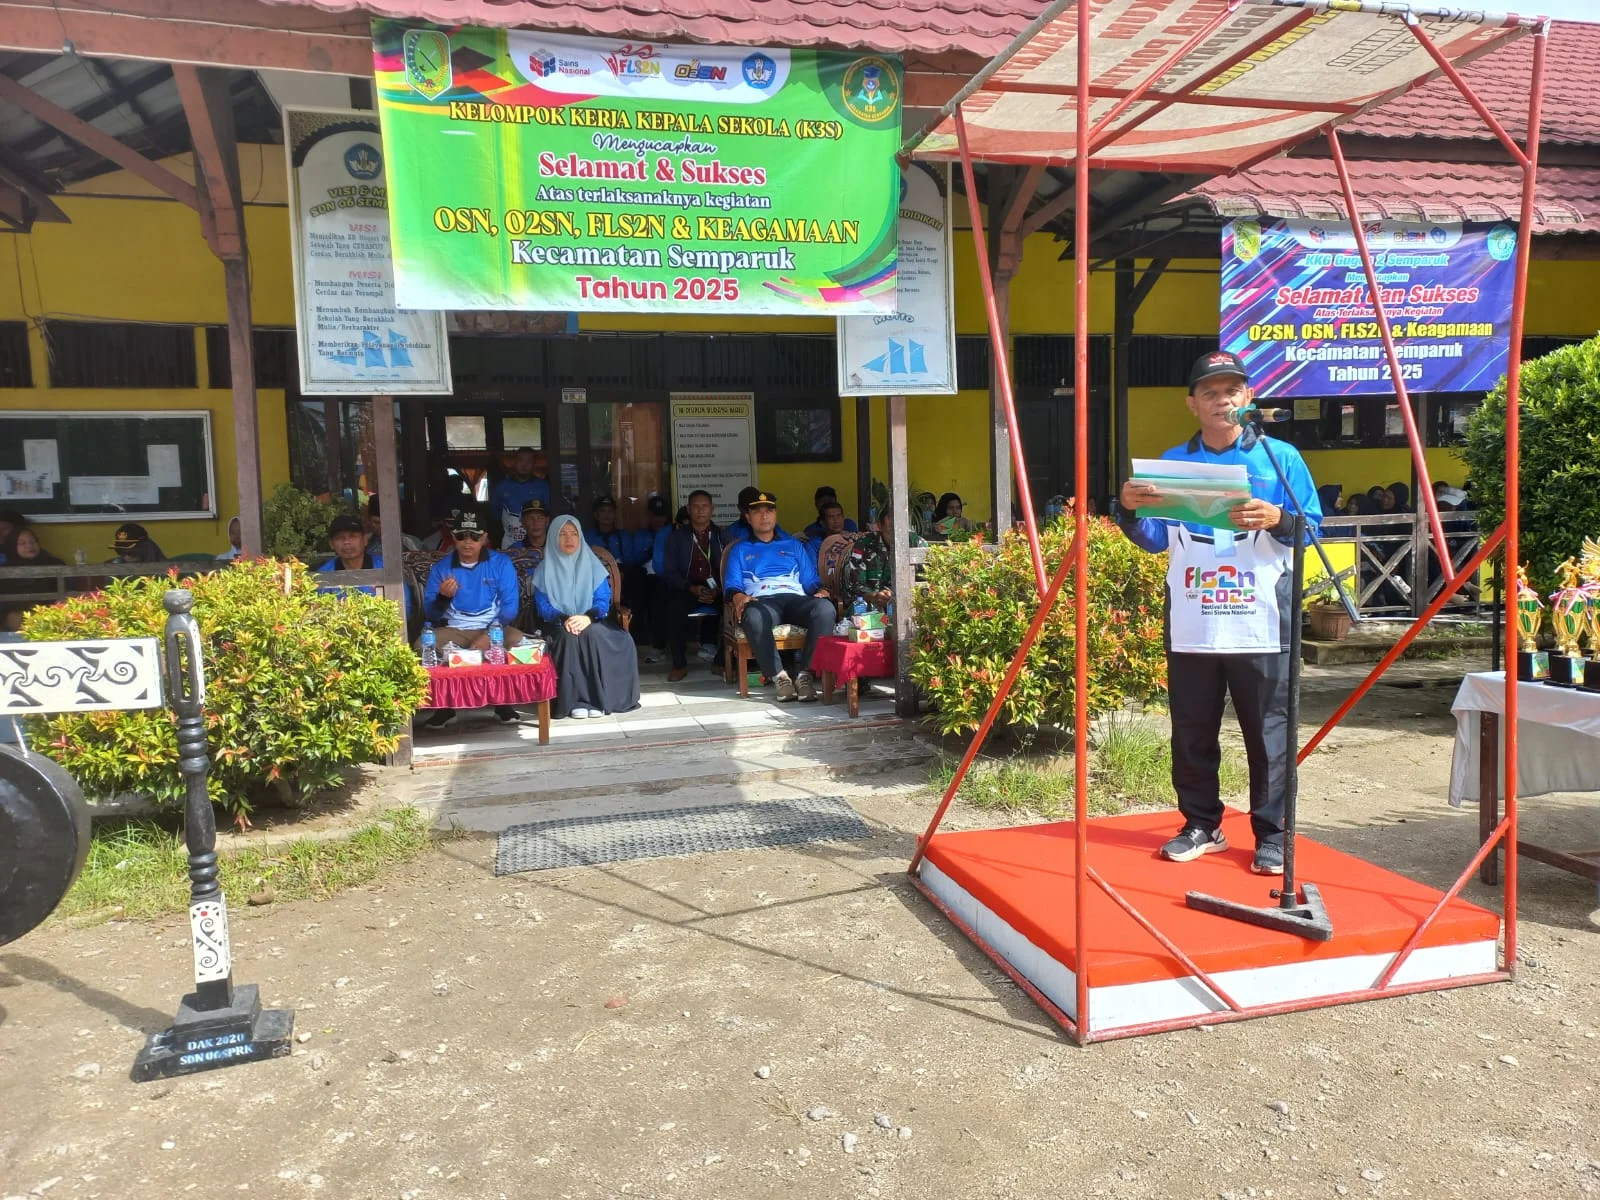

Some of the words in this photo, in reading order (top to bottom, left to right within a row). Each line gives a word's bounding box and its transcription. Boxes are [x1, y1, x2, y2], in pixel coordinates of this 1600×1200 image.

[558, 59, 579, 67] Sains
[558, 66, 591, 76] Nasional
[450, 101, 565, 126] KELOMPOK
[570, 107, 632, 129] KERJA
[636, 111, 714, 134] KEPALA
[718, 115, 791, 138] SEKOLA
[795, 119, 843, 140] (K3S)
[592, 132, 716, 158] Mengucapkan
[539, 151, 649, 180] Selamat
[655, 157, 675, 183] &
[681, 158, 767, 185] Sukses
[327, 185, 357, 199] VISI
[359, 184, 370, 197] &
[536, 185, 574, 202] Atas
[578, 187, 701, 210] terlaksanaknya
[704, 191, 772, 210] kegiatan
[310, 200, 337, 217] SDN
[433, 206, 498, 237] OSN,
[504, 209, 581, 239] O2SN,
[586, 212, 665, 239] FLS2N
[671, 215, 692, 240] &
[697, 216, 860, 244] KEAGAMAAN
[511, 239, 662, 268] Kecamatan
[667, 244, 796, 274] Semparuk
[1305, 253, 1332, 267] KKG
[1335, 254, 1374, 269] Gug
[1376, 254, 1386, 267] 2
[1387, 254, 1449, 269] Semparuk
[575, 276, 667, 299] Tahun
[673, 276, 739, 301] 2025
[1277, 286, 1363, 306] Selamat
[1408, 285, 1478, 304] Sukses
[1314, 308, 1336, 318] Atas
[1404, 307, 1444, 317] Kegiatan
[1248, 323, 1299, 342] O2SN,
[1301, 322, 1338, 341] OSN,
[1391, 323, 1405, 340] &
[1406, 321, 1494, 339] Keagamaan
[1285, 345, 1381, 362] Kecamatan
[1328, 365, 1379, 382] Tahun
[1382, 364, 1423, 381] 225
[1201, 589, 1256, 603] 2025
[187, 1038, 214, 1051] DAK
[215, 1033, 245, 1046] 2020
[180, 1052, 204, 1065] SDN
